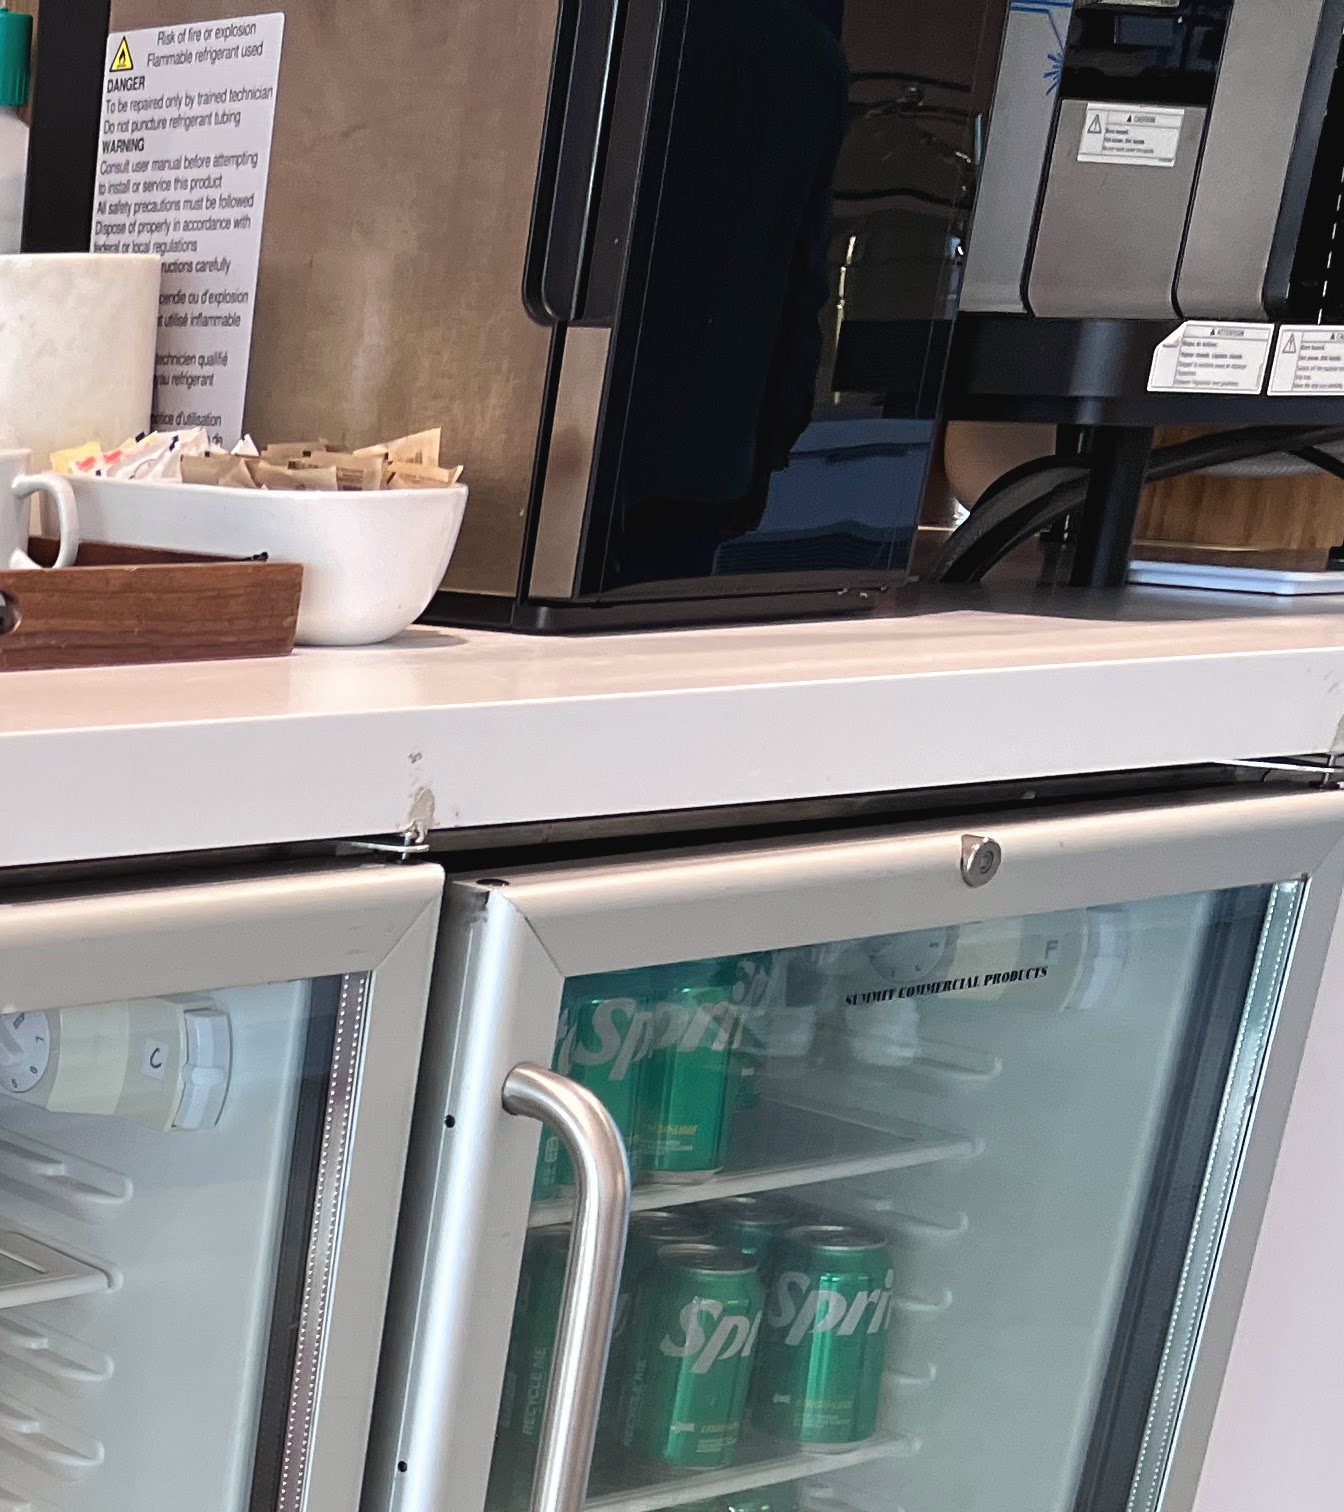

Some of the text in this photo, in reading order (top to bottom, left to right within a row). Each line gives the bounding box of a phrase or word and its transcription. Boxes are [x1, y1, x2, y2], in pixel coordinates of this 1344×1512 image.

[157, 22, 256, 46] Risk of fire or explosion
[147, 41, 264, 68] Flammable refrigerant used
[107, 76, 145, 93] DANGER
[106, 85, 273, 113] To be repaired only by trained technician
[104, 110, 241, 134] Do not puncture refrigerant tubing
[102, 138, 145, 155] WARNING
[100, 152, 258, 175] Consult user manual before attempting
[98, 175, 222, 196] to install or service this product
[97, 193, 254, 217] All safety precautions must be followed
[95, 214, 251, 237] Dispose of properly in accordance with
[153, 238, 198, 257] regulations
[196, 257, 231, 274] carefully
[845, 966, 1049, 1006] SUMMIT COMMERCIAL PRODUCTS
